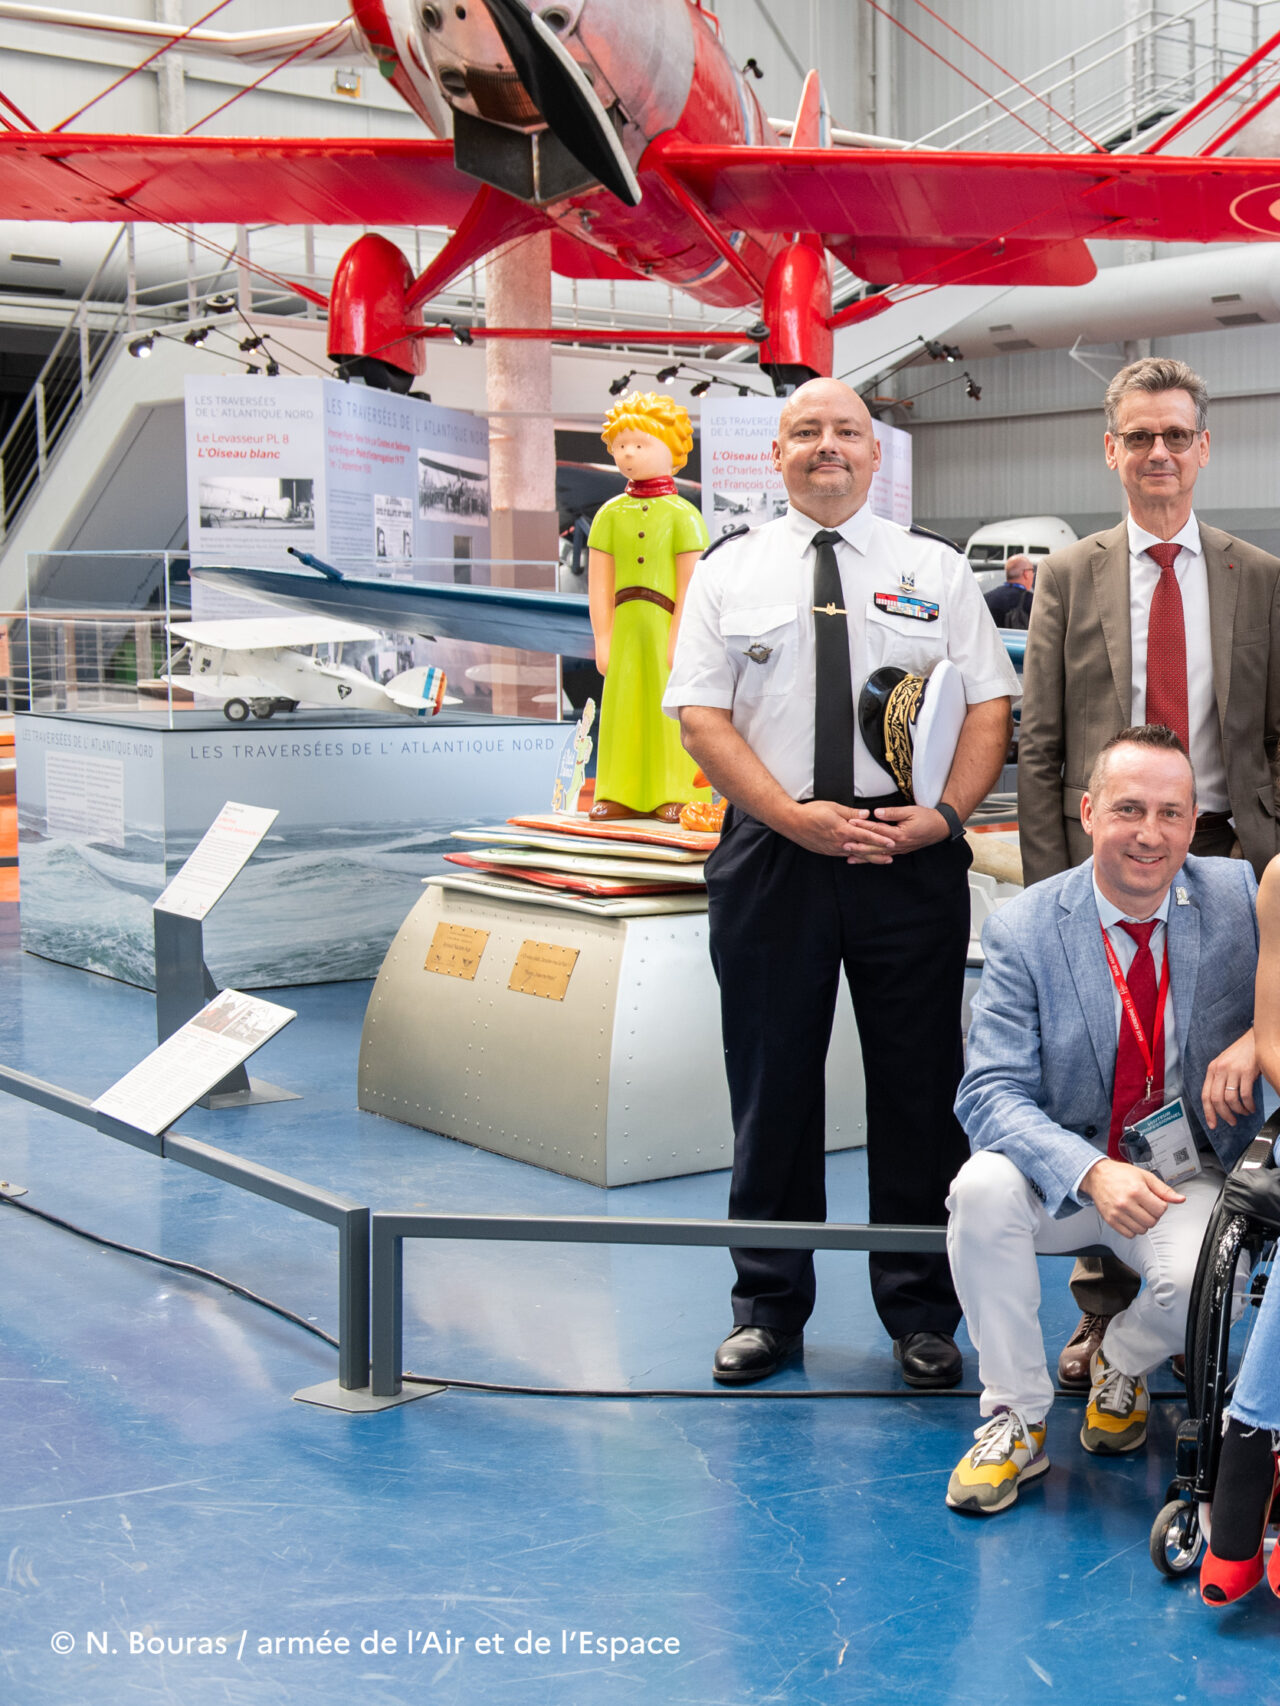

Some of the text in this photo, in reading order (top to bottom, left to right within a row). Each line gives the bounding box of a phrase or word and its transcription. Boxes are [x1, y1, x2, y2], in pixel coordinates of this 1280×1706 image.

[195, 395, 276, 406] LES TRAVERSÉES
[196, 408, 208, 417] DE
[222, 409, 282, 419] ATLANTIQUE
[285, 410, 314, 420] NORD
[326, 398, 342, 416] LES
[347, 401, 397, 428] TRAVERSÉES
[401, 415, 410, 431] DE
[424, 420, 466, 443] ATLANTIQUE
[710, 416, 778, 426] LES TRAVERSÉE
[196, 432, 209, 442] Le
[212, 433, 264, 444] Levasseur
[266, 434, 279, 444] PL
[710, 428, 722, 436] DE
[734, 428, 778, 437] ATLANTIQ
[198, 448, 280, 459] L'Oiseau blanc
[713, 451, 758, 460] L'Oiseau
[712, 466, 724, 475] de
[727, 465, 762, 475] Charles
[712, 480, 721, 488] et
[725, 480, 763, 490] François
[74, 735, 82, 749] DE
[91, 738, 131, 755] ATLANTIQUE
[133, 744, 153, 758] NORD
[191, 746, 222, 759] LES
[232, 741, 344, 758] TRAVERSÉES
[352, 743, 372, 756] DE
[401, 740, 504, 755] ATLANTIQUE
[512, 738, 554, 751] NORD
[1147, 1111, 1172, 1126] VISITEUR
